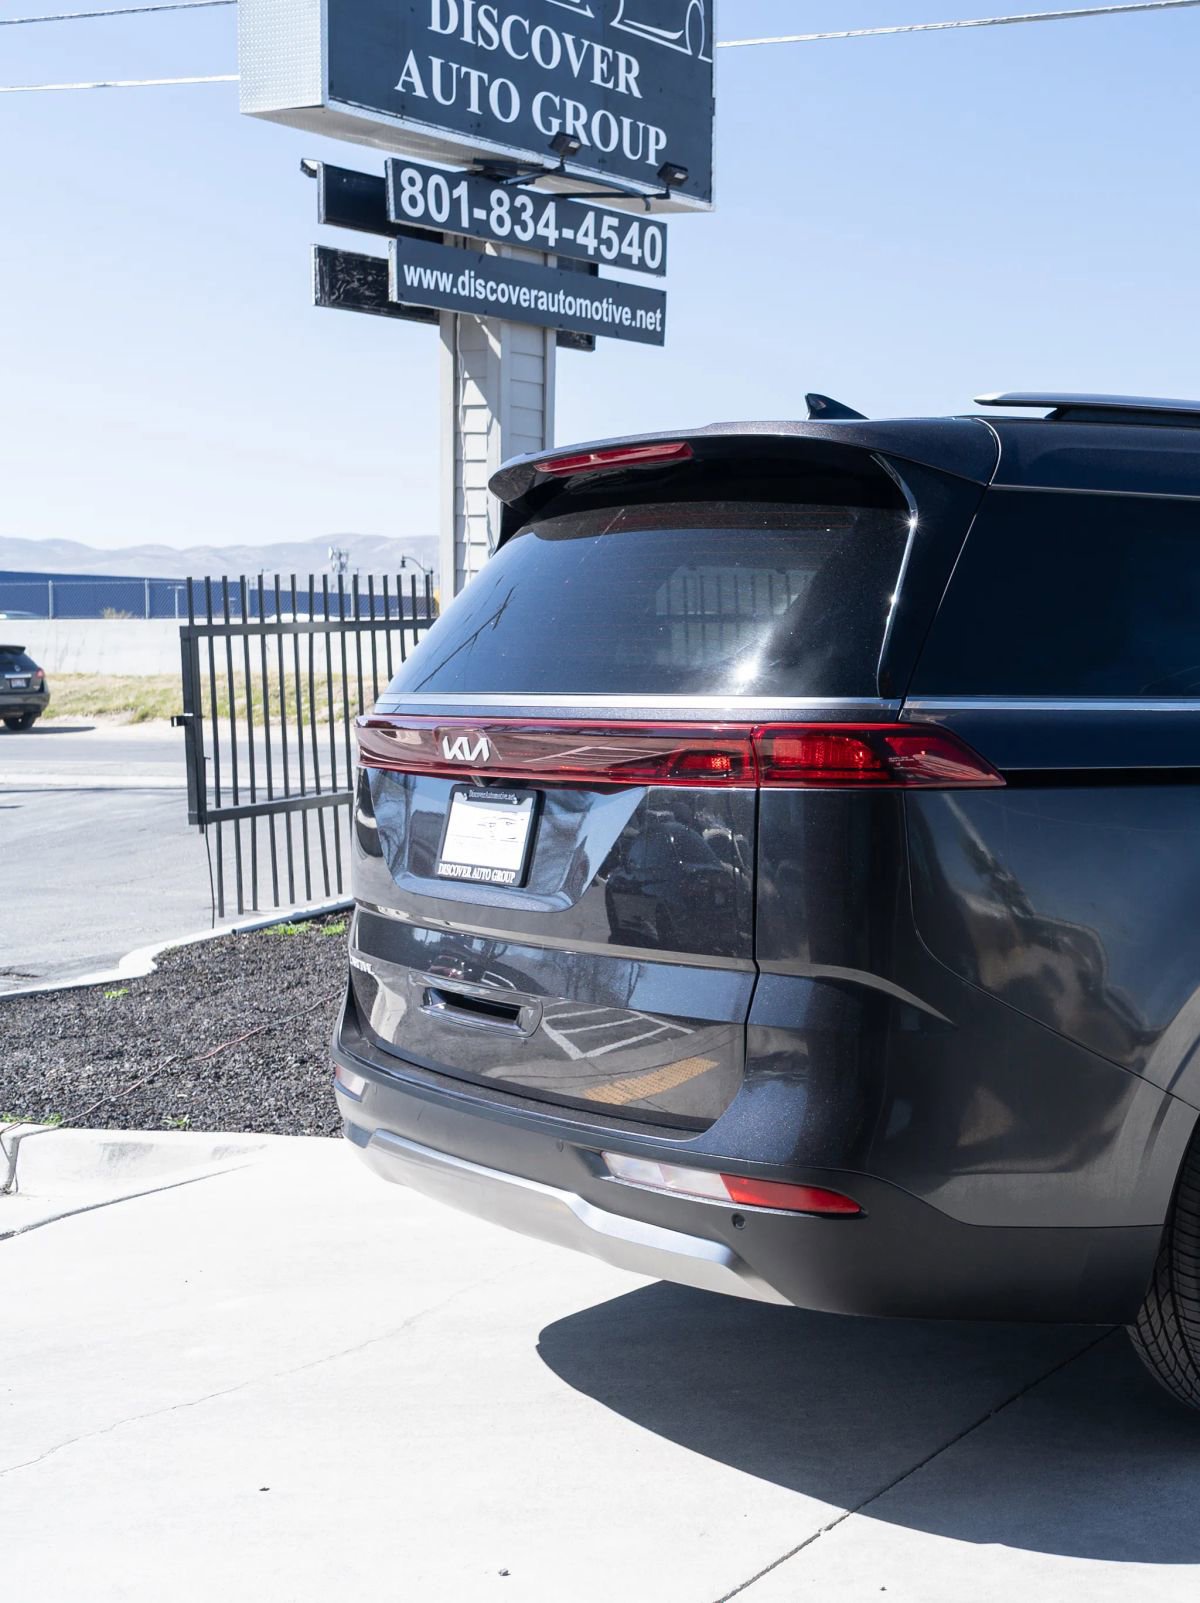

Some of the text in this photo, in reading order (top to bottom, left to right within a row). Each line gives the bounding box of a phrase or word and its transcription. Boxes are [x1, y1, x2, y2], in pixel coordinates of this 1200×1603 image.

[428, 0, 643, 99] DISCOVER
[394, 49, 668, 167] AUTO GROUP
[400, 168, 664, 271] 801-834-4540
[403, 262, 662, 333] www.discoverautomotive.net
[442, 736, 491, 762] KIA
[438, 863, 516, 884] DISCOVER AUTO GROUP
